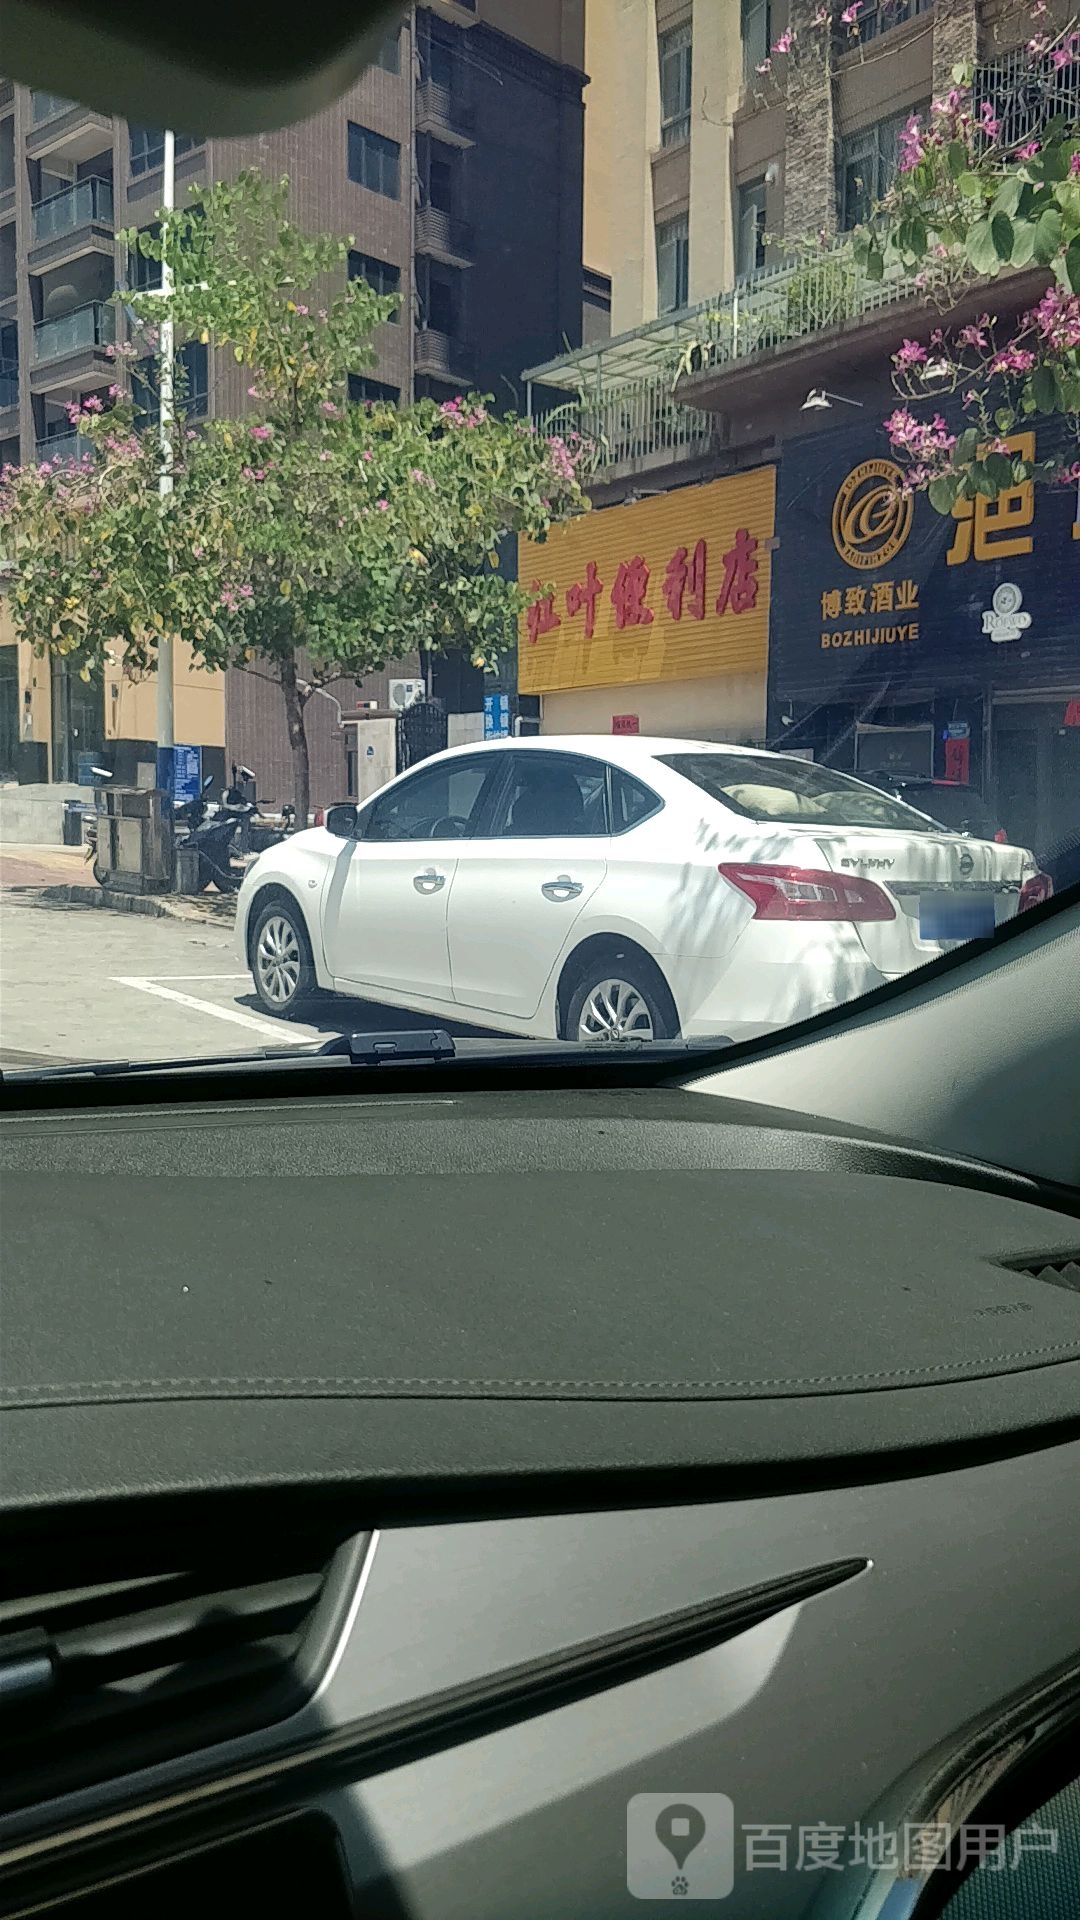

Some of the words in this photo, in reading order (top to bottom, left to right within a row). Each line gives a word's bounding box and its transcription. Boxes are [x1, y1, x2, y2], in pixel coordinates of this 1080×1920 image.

[820, 579, 920, 622] 博致酒业
[820, 623, 920, 649] BOZHIJIUYE
